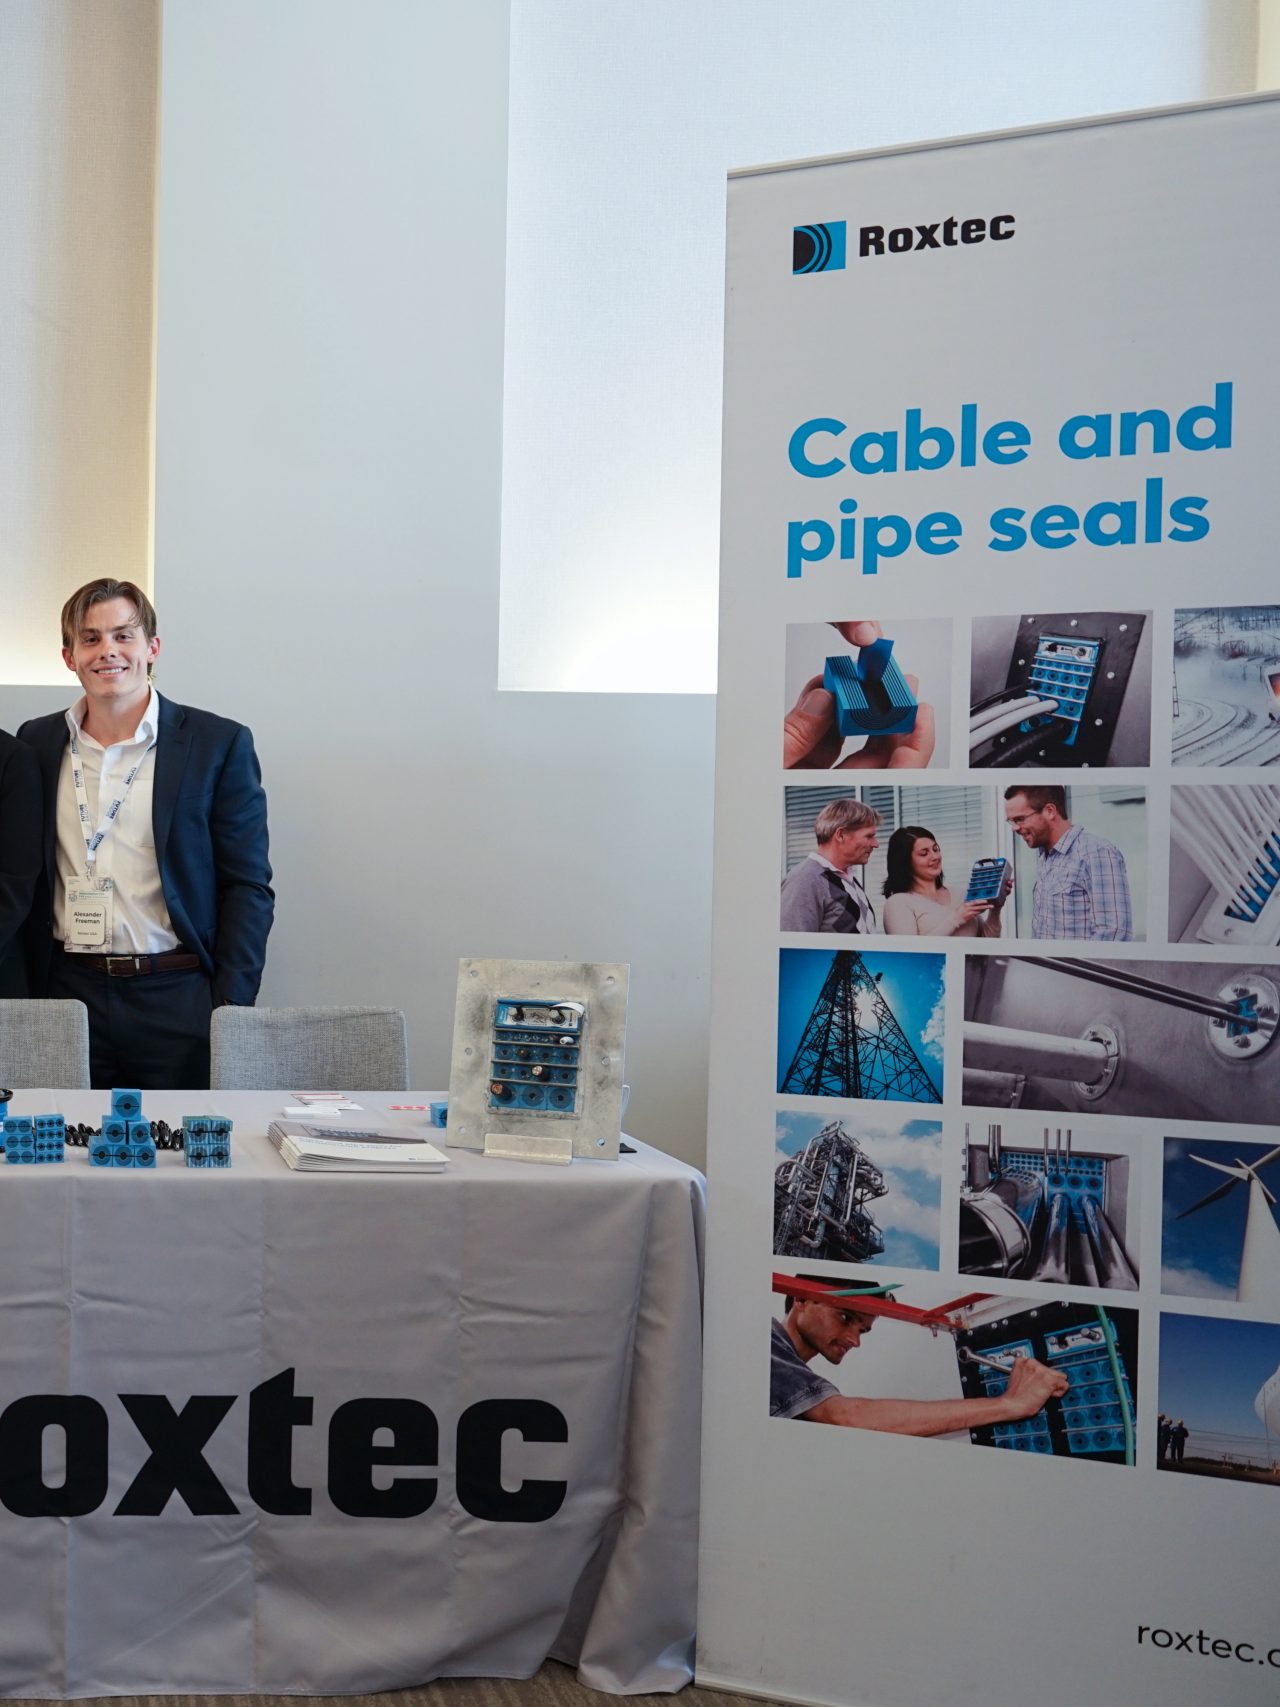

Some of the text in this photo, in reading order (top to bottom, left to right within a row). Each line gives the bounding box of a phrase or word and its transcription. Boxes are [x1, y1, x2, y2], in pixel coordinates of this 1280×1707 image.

[858, 214, 1016, 257] Roxtec
[788, 381, 1233, 479] Cable and
[786, 476, 1210, 579] pipe seals
